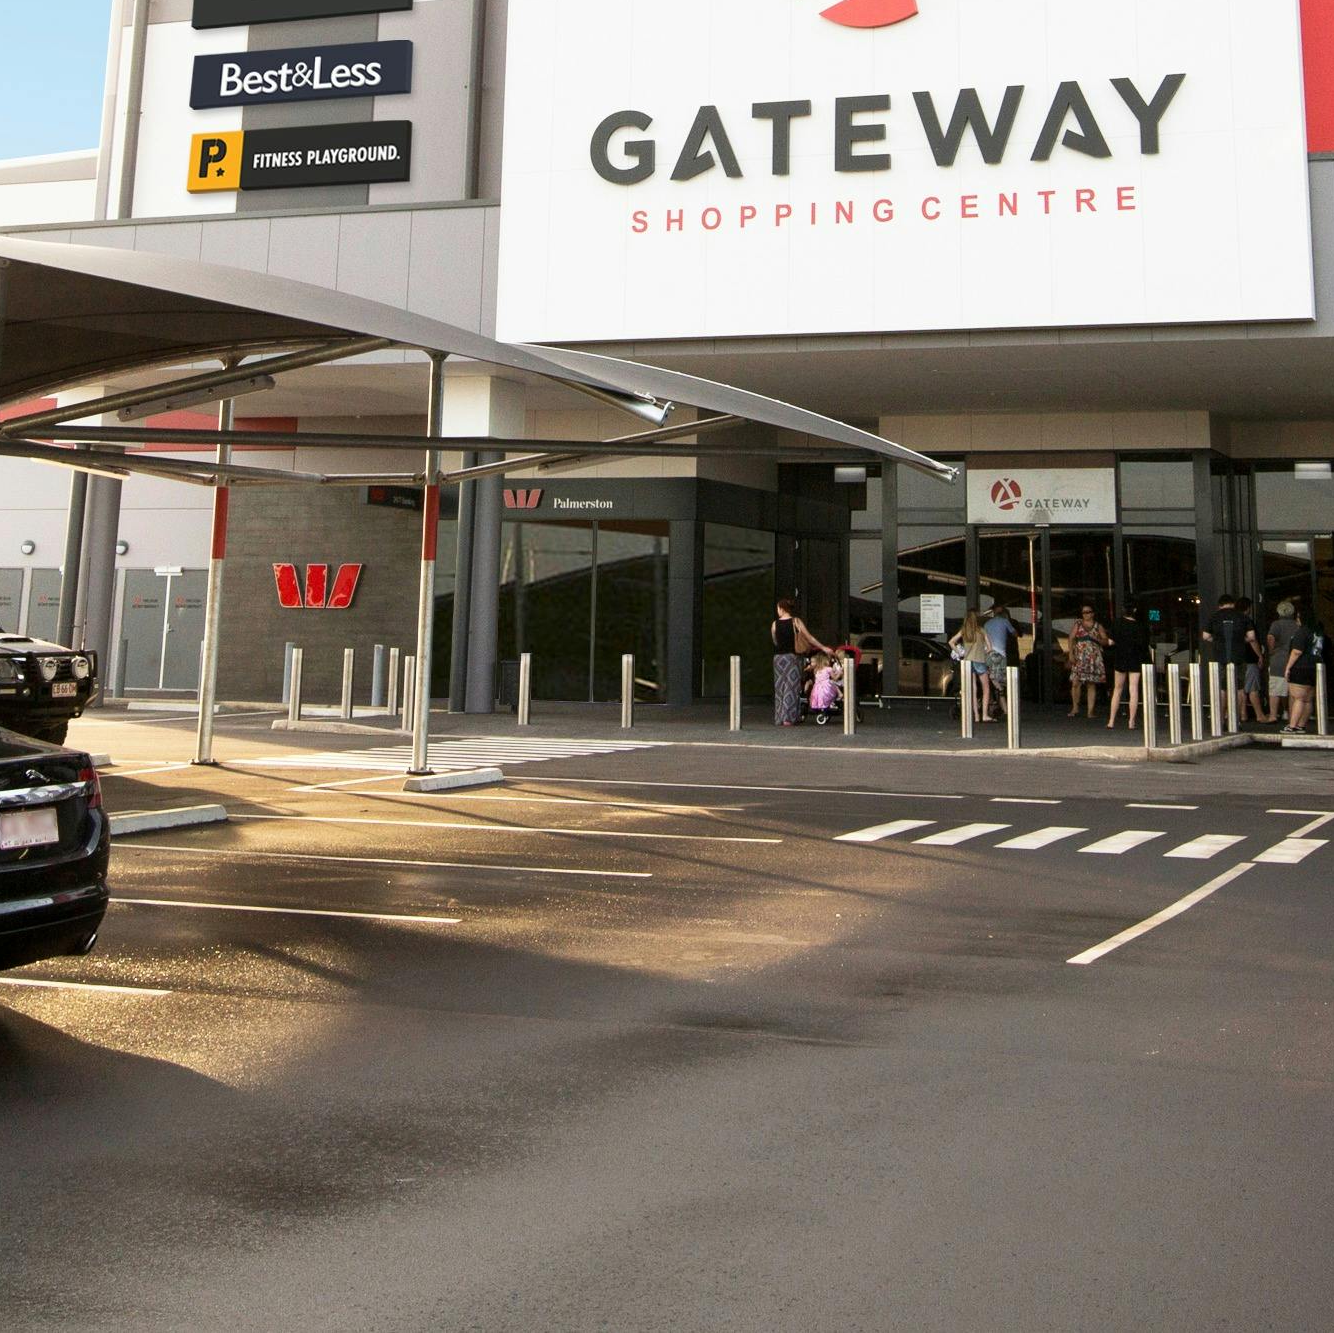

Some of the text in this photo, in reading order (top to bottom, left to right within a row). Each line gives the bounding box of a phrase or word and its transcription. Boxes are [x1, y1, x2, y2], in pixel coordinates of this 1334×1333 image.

[219, 56, 382, 97] Best&Less
[589, 73, 1187, 186] GATEWAY
[252, 149, 303, 169] FITNESS
[630, 185, 1137, 234] SHOPPING CENTRE
[553, 497, 613, 509] Palmerston
[1024, 498, 1090, 509] GATEWAY
